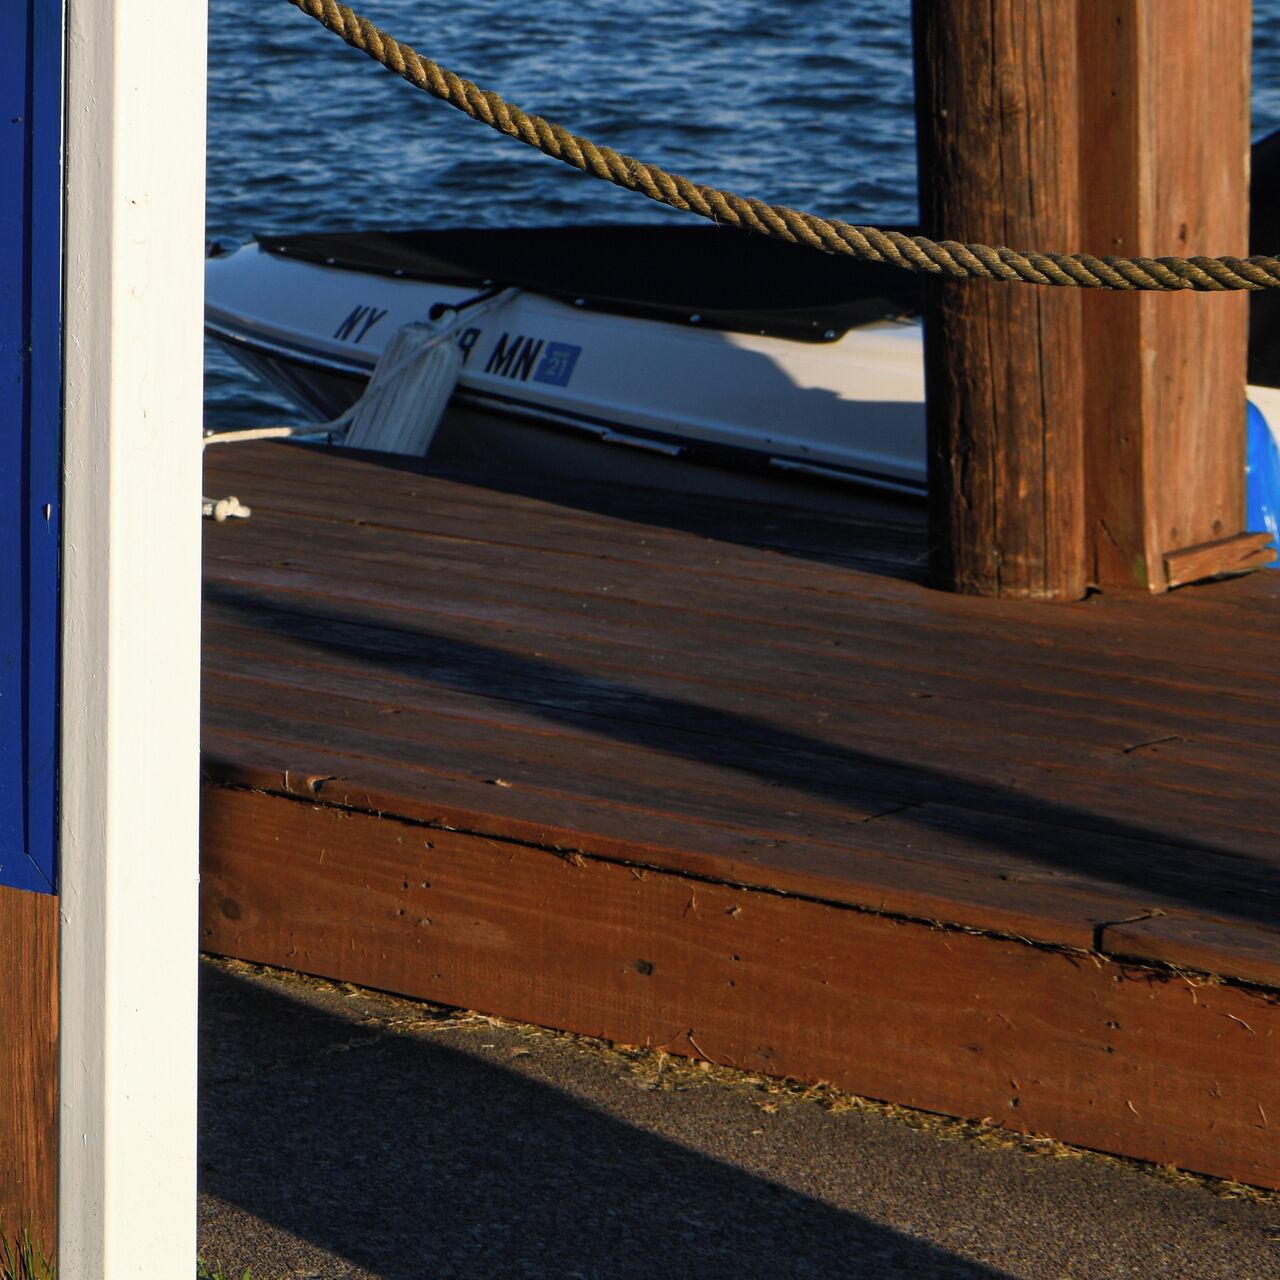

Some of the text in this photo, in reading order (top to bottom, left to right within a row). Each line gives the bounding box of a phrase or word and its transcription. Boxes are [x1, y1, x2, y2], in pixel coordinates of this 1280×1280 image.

[333, 304, 389, 344] NY
[484, 332, 545, 382] MN
[544, 357, 568, 377] 21
